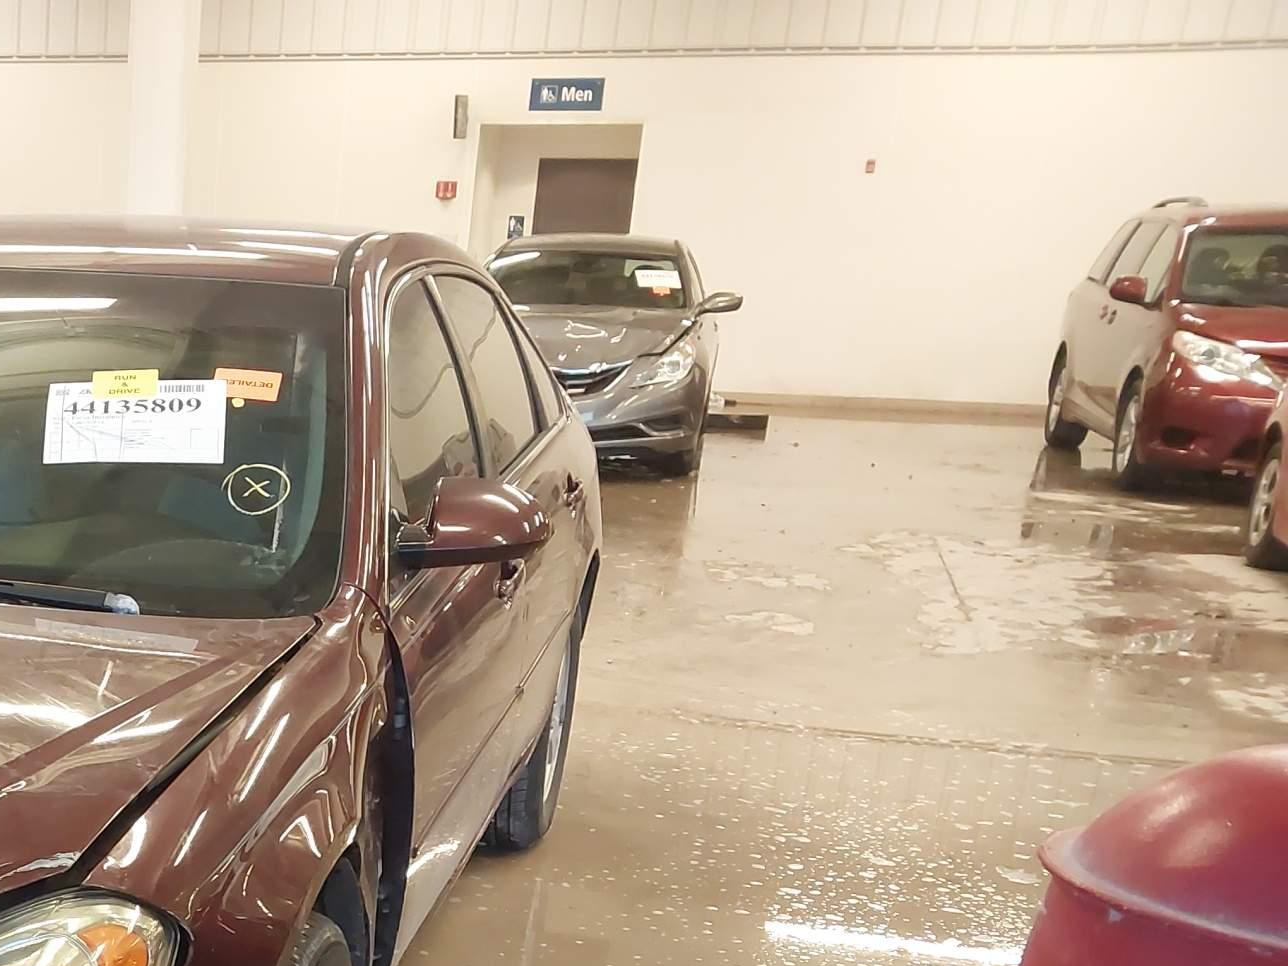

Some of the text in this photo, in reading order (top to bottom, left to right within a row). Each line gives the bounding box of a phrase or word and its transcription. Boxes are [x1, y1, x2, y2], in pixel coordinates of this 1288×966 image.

[560, 86, 593, 102] Men
[226, 379, 274, 389] DETAILE
[108, 387, 141, 395] DRIVE
[63, 397, 203, 415] 44135809
